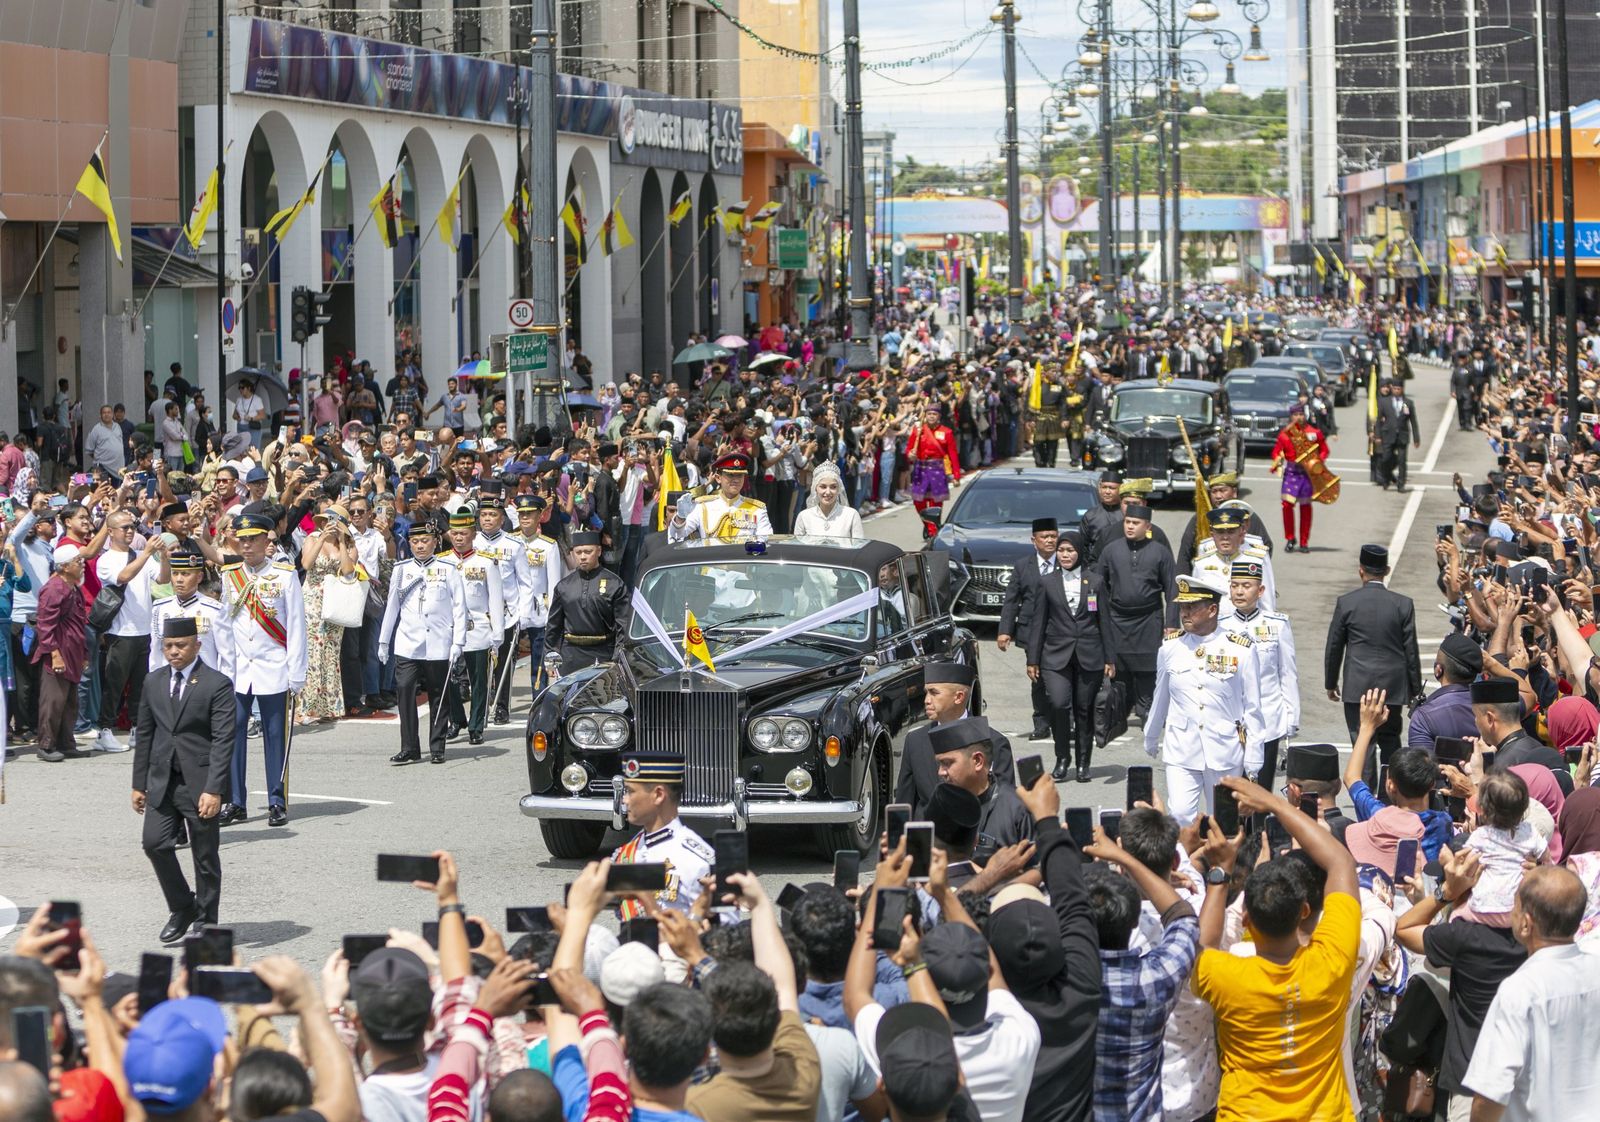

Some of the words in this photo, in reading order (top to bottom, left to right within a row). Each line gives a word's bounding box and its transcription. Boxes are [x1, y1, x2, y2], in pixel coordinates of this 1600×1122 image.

[388, 62, 413, 77] standard
[386, 77, 413, 91] chartered
[636, 109, 680, 148] BURGER
[683, 118, 709, 153] KING
[516, 307, 528, 318] 50
[987, 594, 1000, 603] BG
